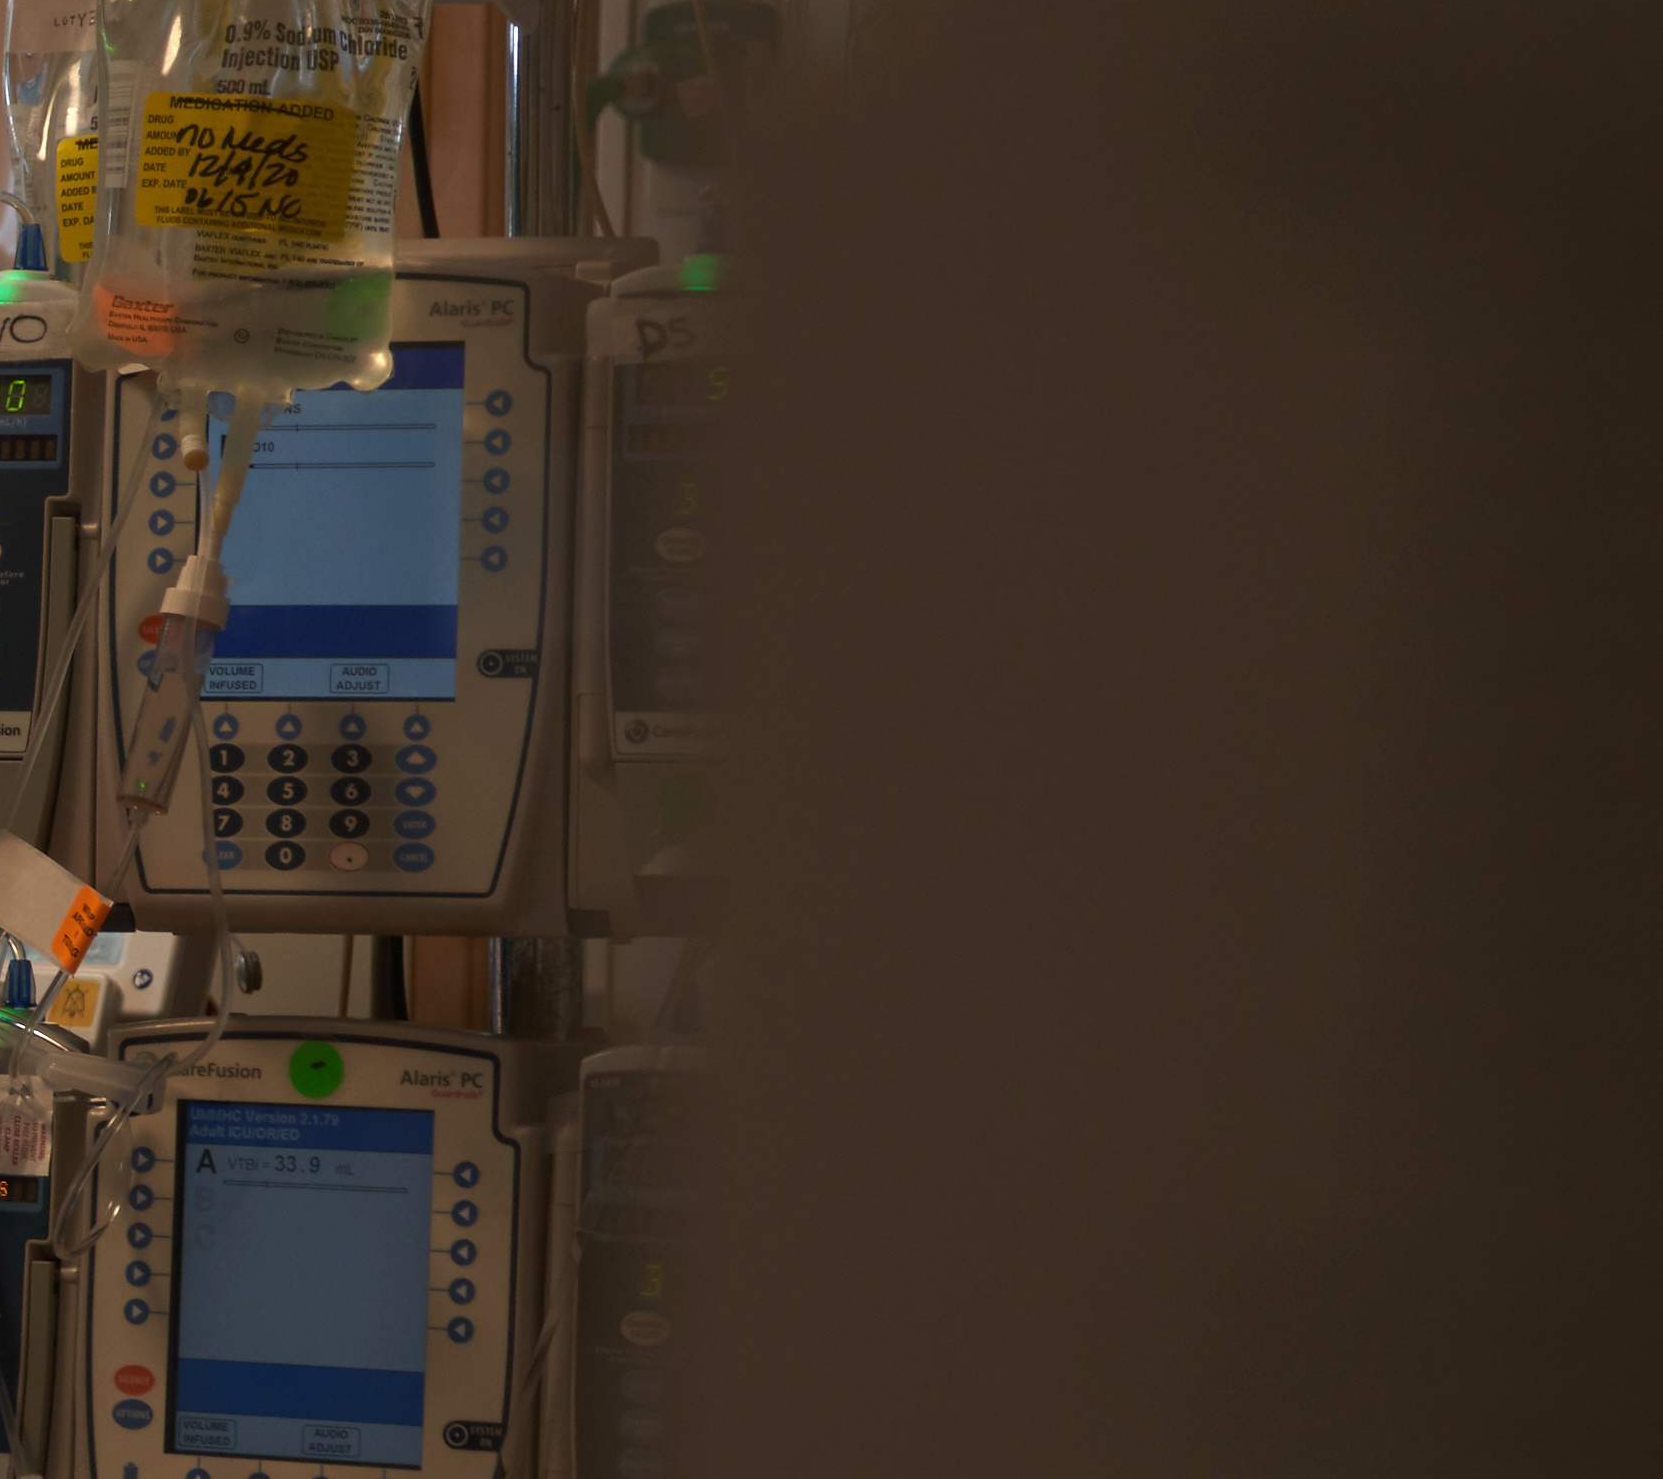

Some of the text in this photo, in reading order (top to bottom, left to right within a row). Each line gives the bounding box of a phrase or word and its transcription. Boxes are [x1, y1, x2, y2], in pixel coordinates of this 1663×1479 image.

[225, 20, 271, 45] 0.9%
[339, 29, 409, 60] Chloride
[222, 47, 339, 72] Injection USP
[217, 79, 246, 94] 500
[148, 114, 174, 124] DRUG
[279, 103, 335, 122] ADDED
[146, 130, 180, 140] AMOUN
[145, 146, 191, 158] ADDED BY
[60, 157, 84, 168] DRUG
[143, 162, 167, 172] DATE
[60, 171, 96, 182] AMOUNT
[142, 178, 188, 189] EXP. DATE
[61, 186, 89, 197] ADDED
[61, 201, 84, 213] DATE
[429, 299, 515, 318] Alaris PC
[208, 665, 378, 678] VOLUME AUDIO
[209, 679, 382, 692] INFUSED ADJUST
[400, 1069, 450, 1087] Alaris
[460, 1072, 484, 1089] PC
[245, 1110, 297, 1124] Version
[189, 1124, 226, 1139] Adult
[196, 1149, 217, 1174] A
[274, 1156, 321, 1174] 33.9
[183, 1421, 349, 1441] VOLUME AUDIO
[183, 1433, 354, 1455] INFUSED ADJUST
